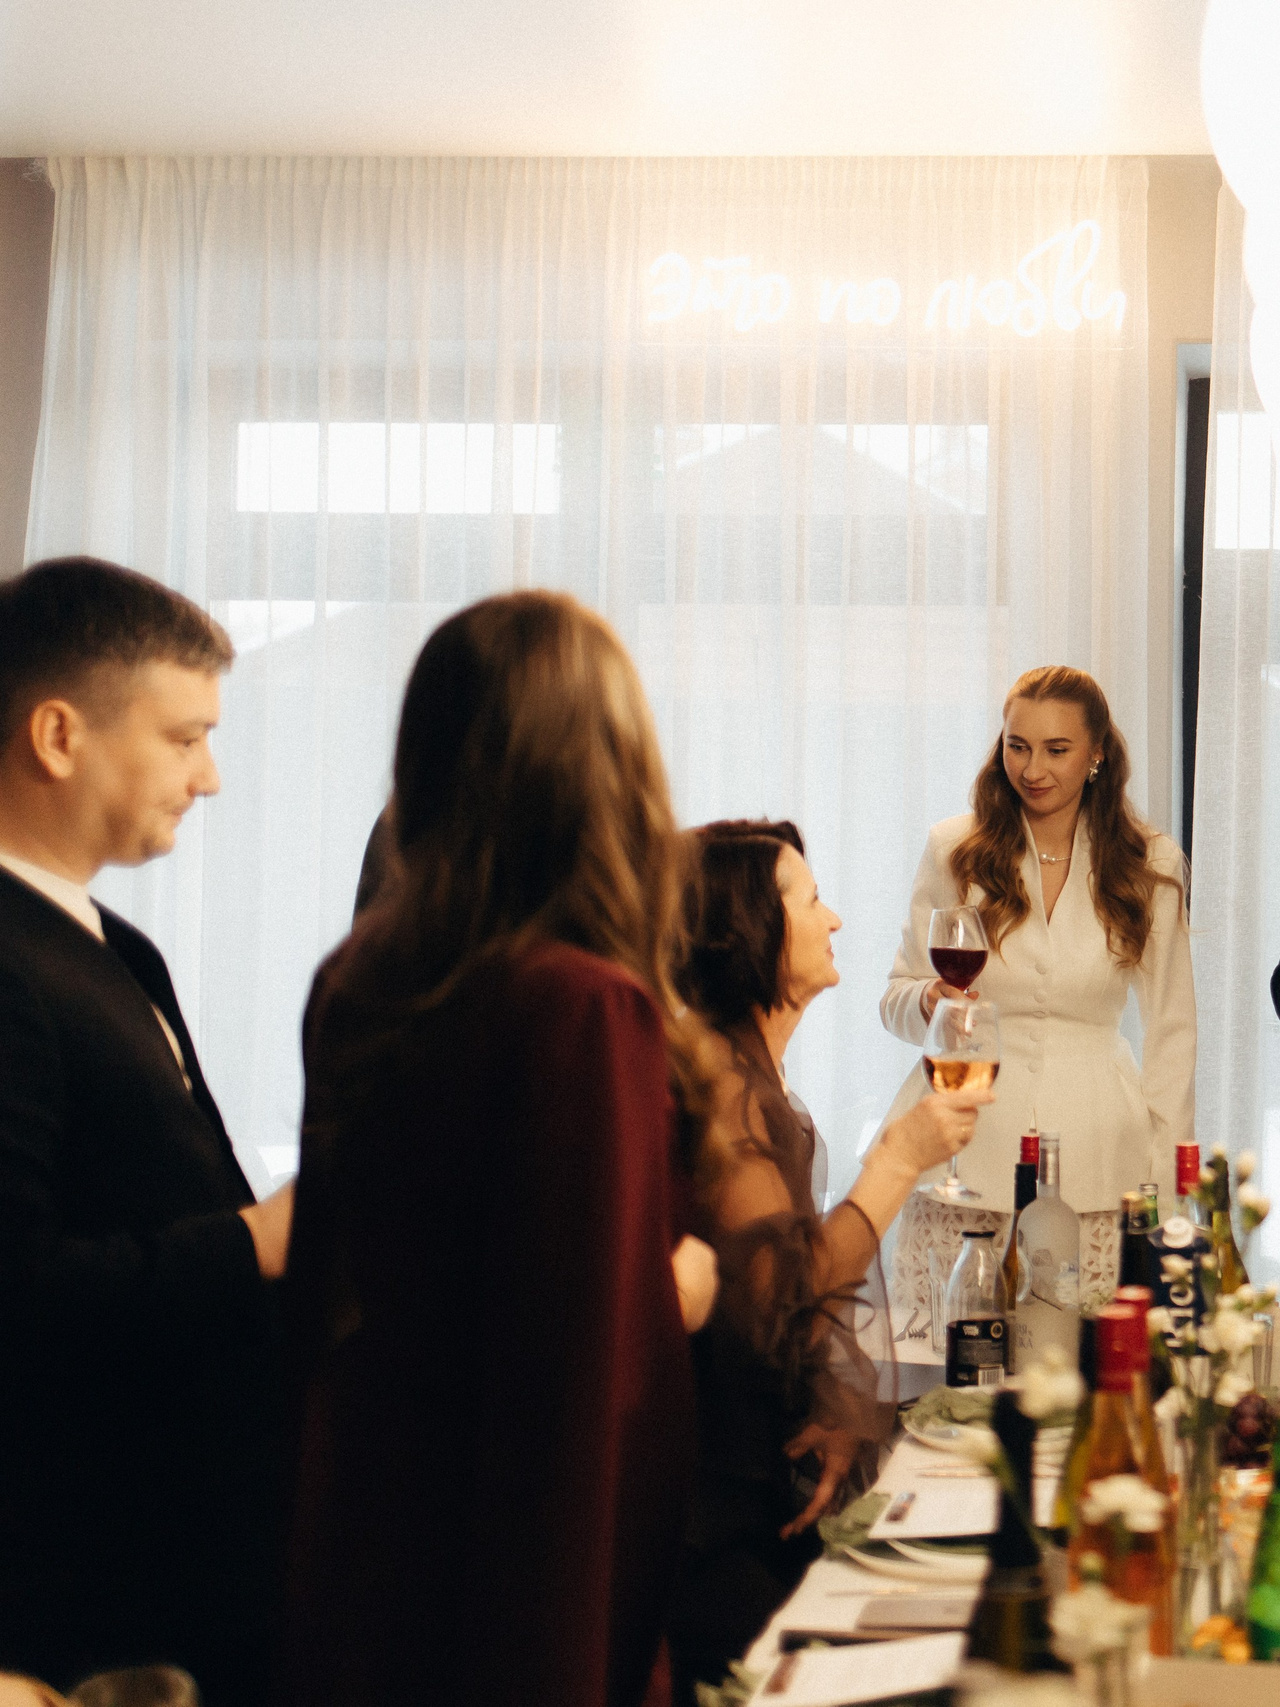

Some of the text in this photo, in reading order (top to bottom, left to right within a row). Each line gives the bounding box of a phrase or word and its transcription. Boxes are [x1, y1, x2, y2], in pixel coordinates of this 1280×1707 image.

[647, 218, 1127, 337] Это по любви
